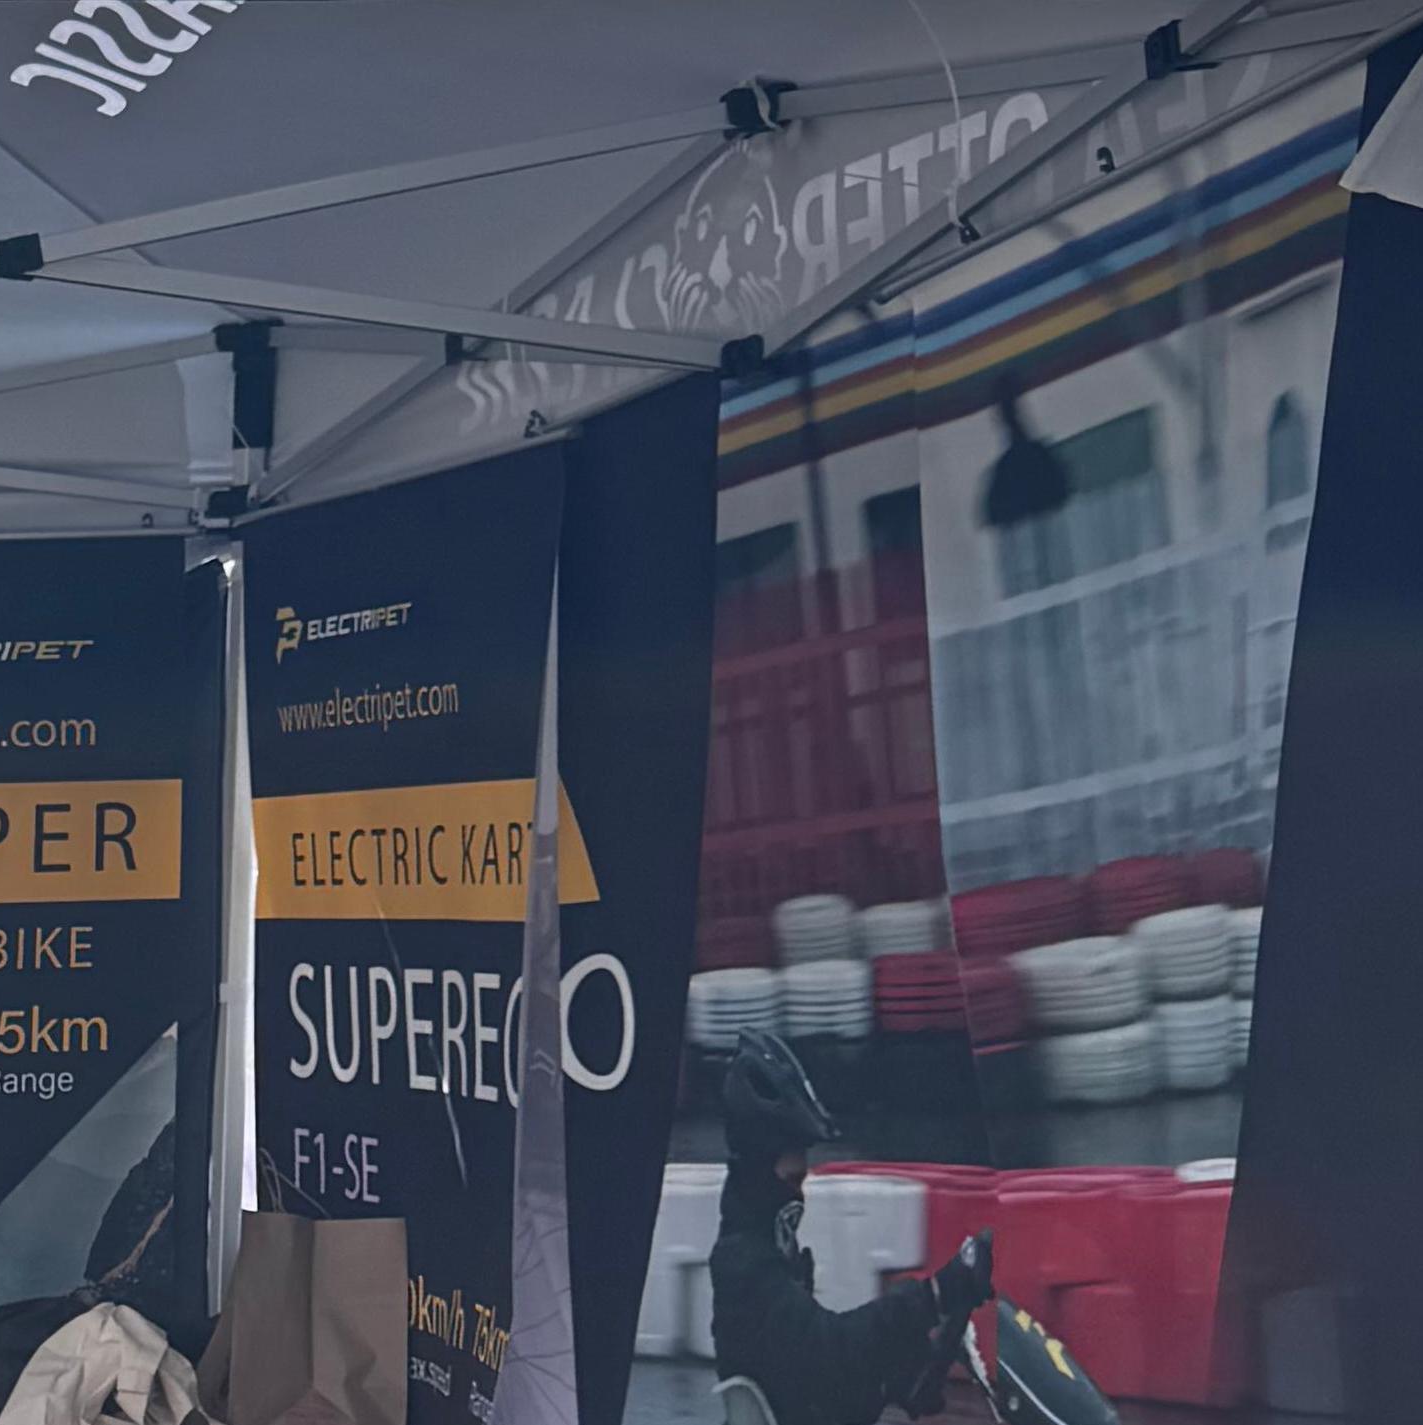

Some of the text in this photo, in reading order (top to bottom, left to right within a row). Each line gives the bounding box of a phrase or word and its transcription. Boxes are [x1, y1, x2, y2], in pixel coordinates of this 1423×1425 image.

[307, 602, 412, 642] ELECTRIPET
[278, 679, 459, 732] www.electripet.com
[292, 824, 448, 887] ELECTRIC
[294, 1128, 380, 1203] F1-SE
